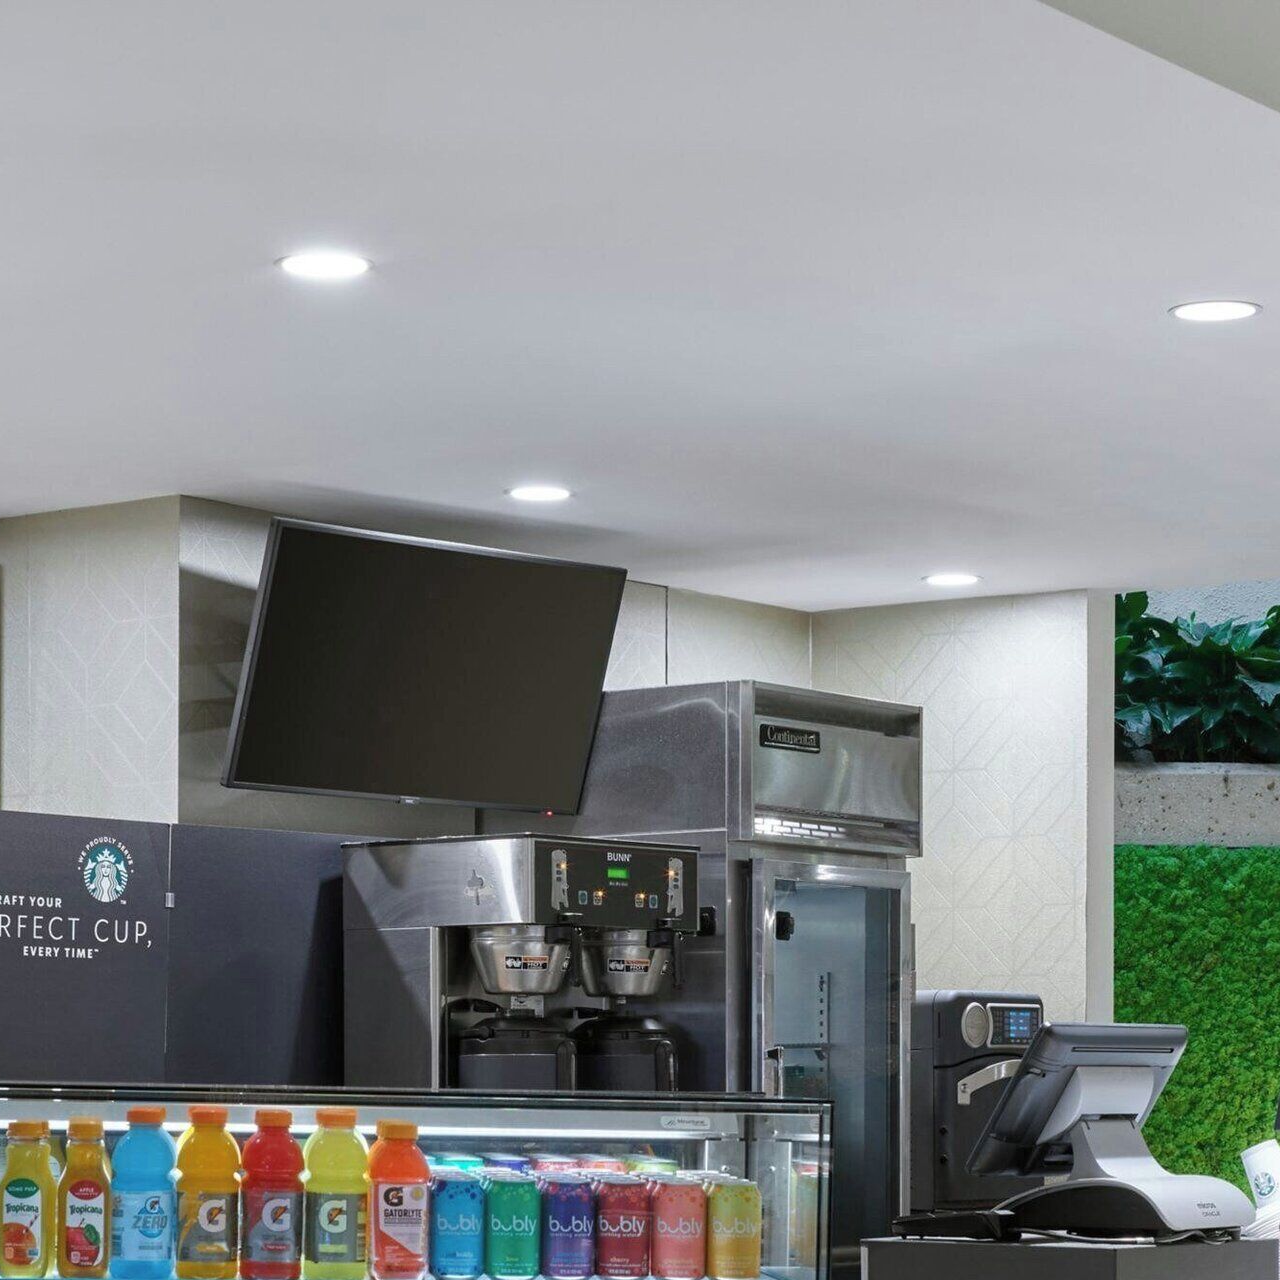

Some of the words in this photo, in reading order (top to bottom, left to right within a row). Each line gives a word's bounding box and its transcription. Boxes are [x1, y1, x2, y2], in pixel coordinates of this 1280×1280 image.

[767, 725, 816, 746] Continental
[78, 850, 87, 863] WE
[85, 836, 116, 850] PROUDLY
[117, 842, 133, 865] SERVE
[29, 896, 62, 908] YOUR
[94, 918, 151, 948] CUP,
[23, 946, 59, 957] EVERY
[5, 1203, 40, 1214] Tropicana
[69, 1205, 103, 1215] Tropicana
[131, 1214, 168, 1230] ZERO
